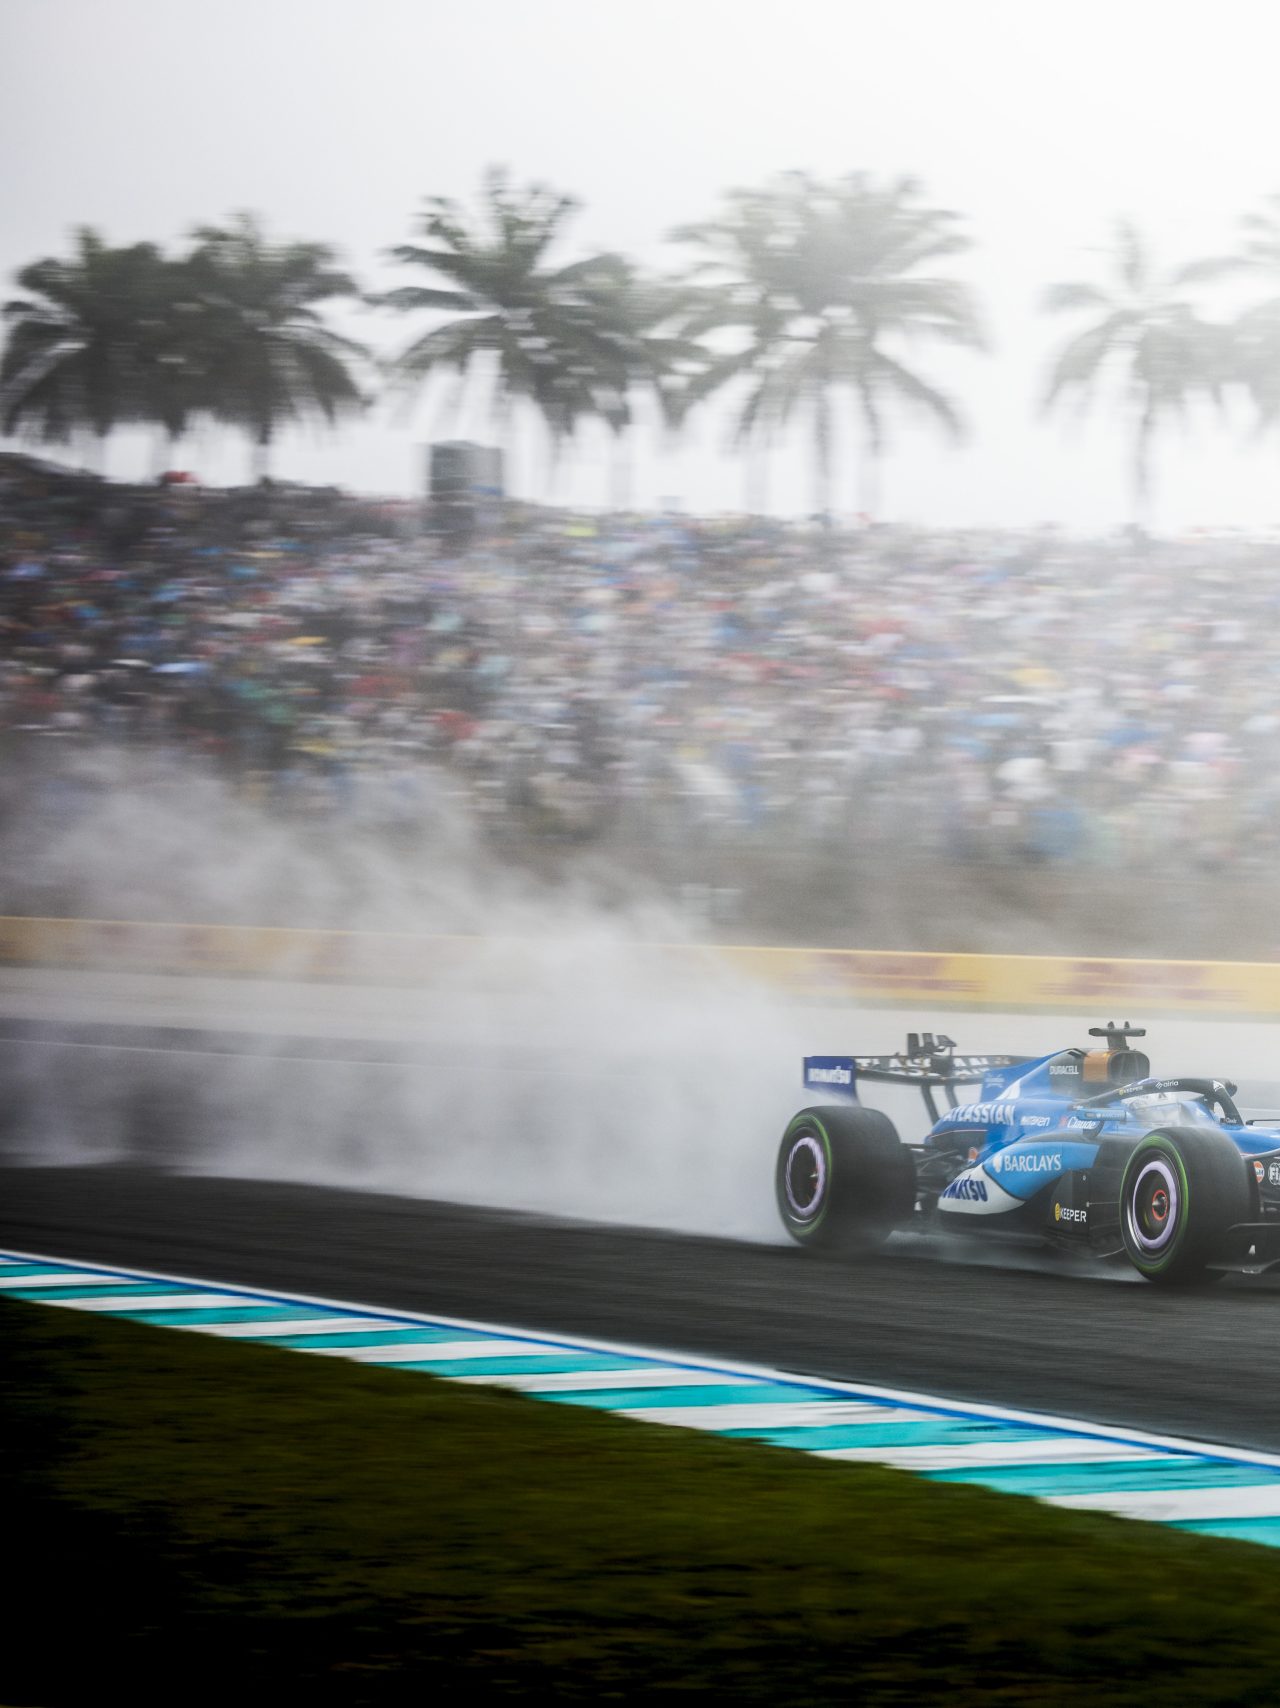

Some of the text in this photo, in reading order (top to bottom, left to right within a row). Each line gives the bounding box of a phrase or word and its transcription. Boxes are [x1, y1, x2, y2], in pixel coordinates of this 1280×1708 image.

[1049, 1065, 1079, 1075] DURACELL
[941, 1103, 1016, 1126] ATLASSIAN
[1067, 1116, 1096, 1130] Claude
[1004, 1154, 1061, 1172] BARCLAYS
[1060, 1207, 1087, 1222] KEEPER
